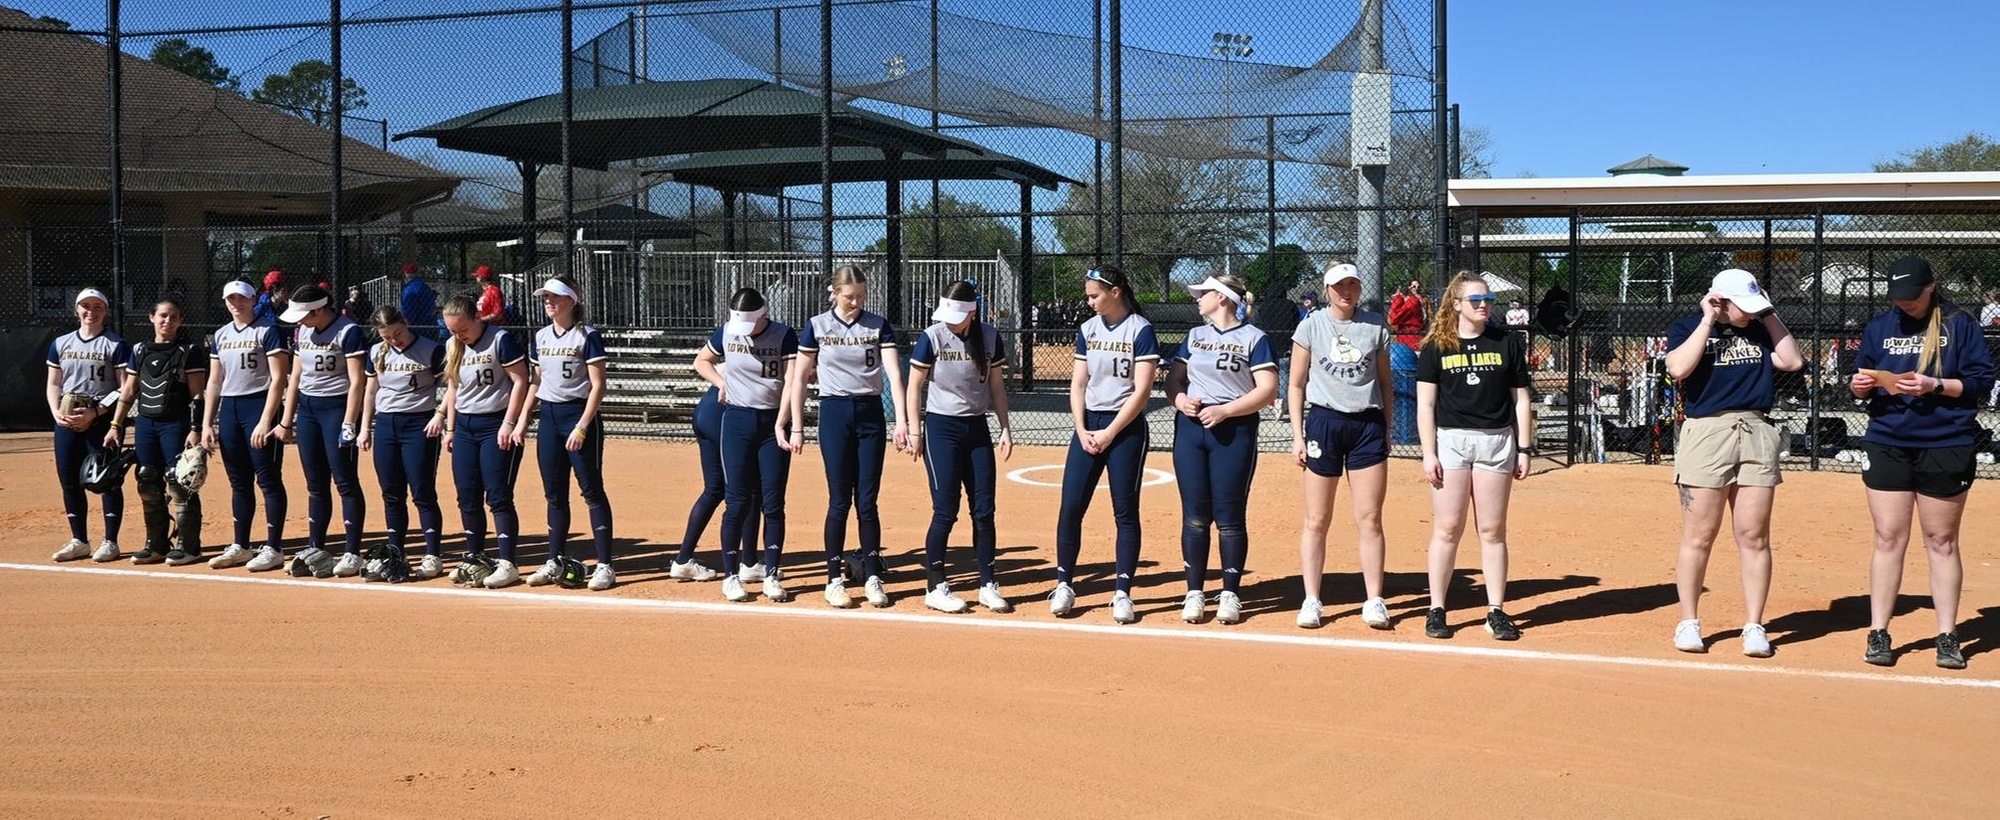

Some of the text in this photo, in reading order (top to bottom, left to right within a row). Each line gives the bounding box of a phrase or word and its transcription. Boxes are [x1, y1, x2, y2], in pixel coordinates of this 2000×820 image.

[233, 339, 258, 349] LAKES
[551, 347, 577, 357] LAKES
[727, 342, 749, 354] IOWA
[1103, 341, 1132, 353] LAKES
[1191, 340, 1213, 352] IOWA
[240, 352, 258, 370] 15
[315, 354, 337, 372] 23
[466, 354, 492, 366] LAKES
[865, 348, 875, 368] 6
[940, 350, 962, 361] IOWA
[1216, 352, 1241, 373] 25
[1441, 353, 1469, 370] IOWA
[90, 364, 107, 382] 14
[394, 362, 423, 373] LAKES
[562, 361, 573, 379] 5
[760, 360, 779, 379] 18
[1112, 357, 1131, 379] 13
[1450, 365, 1495, 375] SOFTBALL
[409, 374, 419, 391] 4
[475, 368, 494, 387] 19
